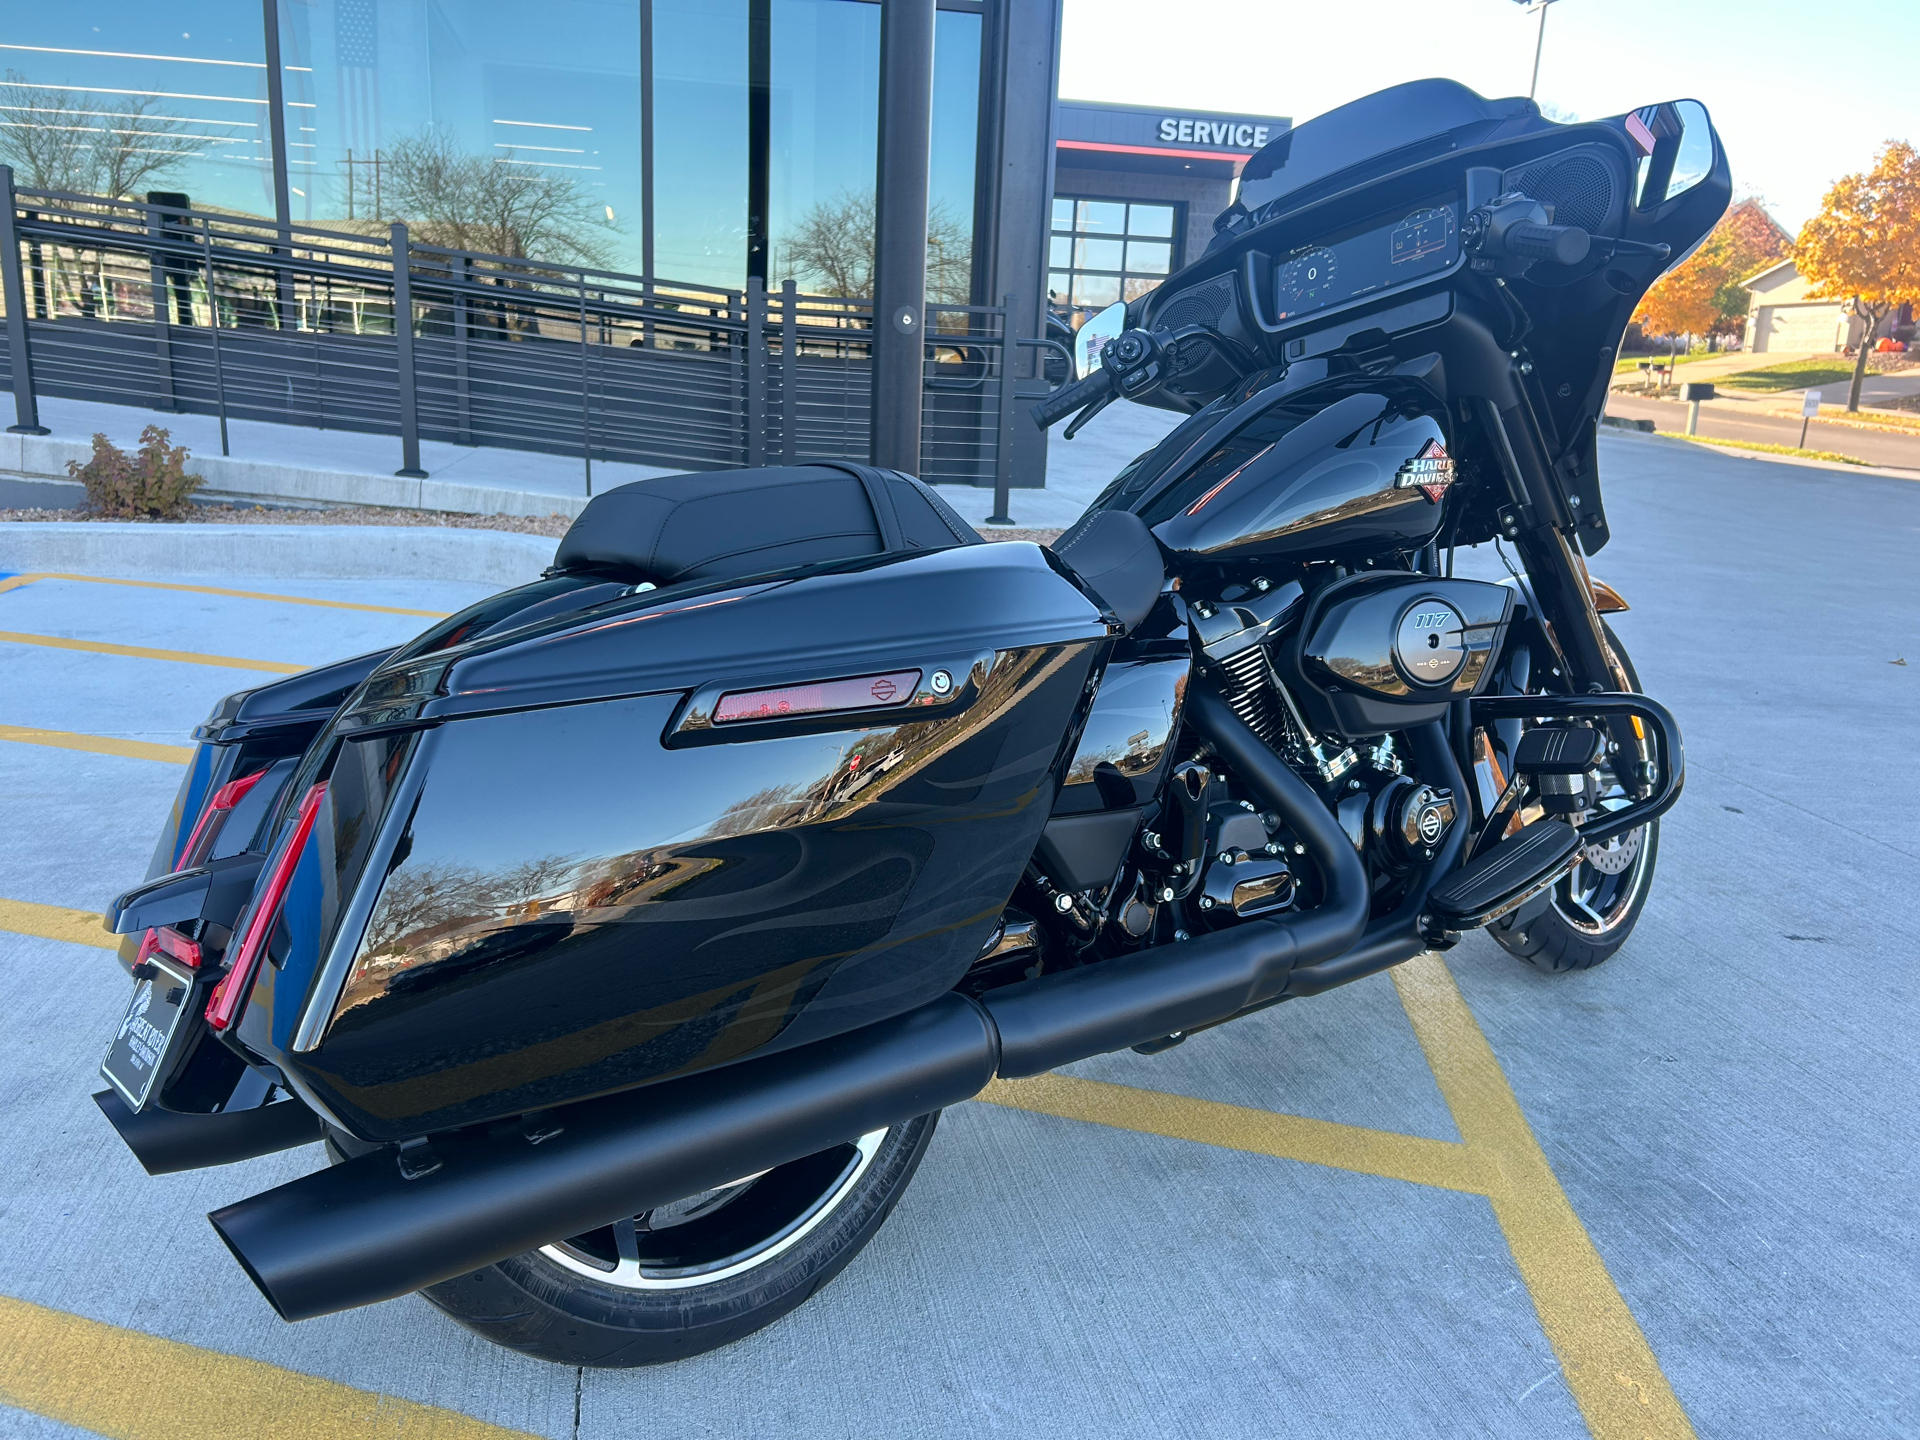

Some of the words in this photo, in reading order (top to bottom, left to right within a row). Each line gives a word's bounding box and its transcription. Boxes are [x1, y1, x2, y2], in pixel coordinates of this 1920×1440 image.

[1160, 118, 1269, 148] SERVICE
[1308, 267, 1317, 280] 0
[1415, 612, 1451, 628] 117
[806, 1217, 838, 1248] REINFORCED
